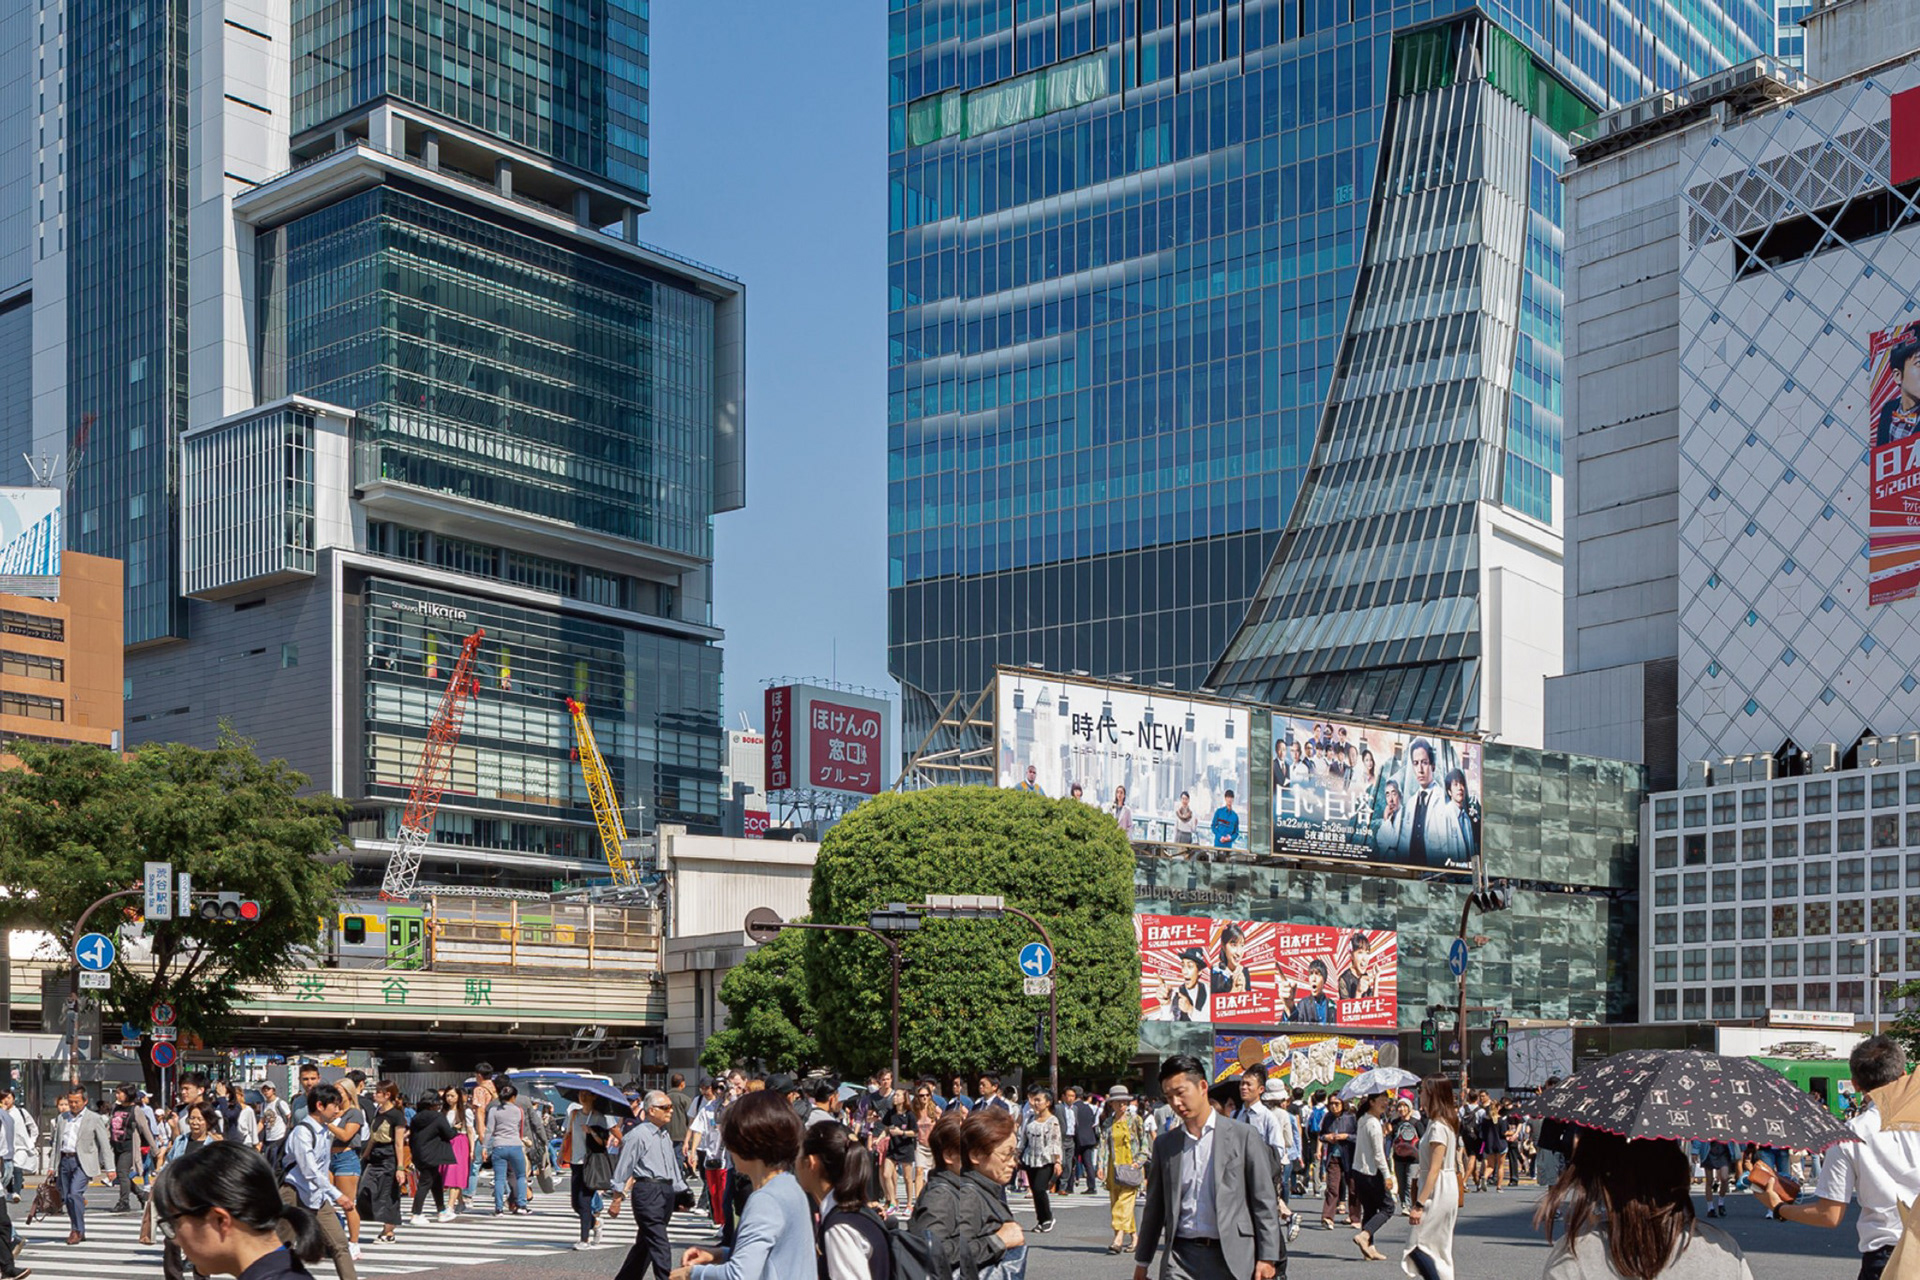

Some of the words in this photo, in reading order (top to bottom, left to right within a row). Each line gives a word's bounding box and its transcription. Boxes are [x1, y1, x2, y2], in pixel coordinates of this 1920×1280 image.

[391, 600, 418, 613] Shibuya
[418, 601, 467, 620] Hikarie
[813, 708, 878, 739] ほけんの
[742, 736, 764, 745] BOSCH
[820, 766, 871, 787] グループ
[1276, 783, 1374, 825] 白い巨塔
[744, 817, 769, 832] ECC
[156, 868, 168, 915] 渋谷駅前
[1189, 889, 1235, 904] station
[1147, 924, 1206, 940] 日本ダービー
[1279, 933, 1333, 949] 日本ダービー
[1215, 993, 1271, 1010] 日本ダービー
[1341, 998, 1393, 1015] 日本ダービー
